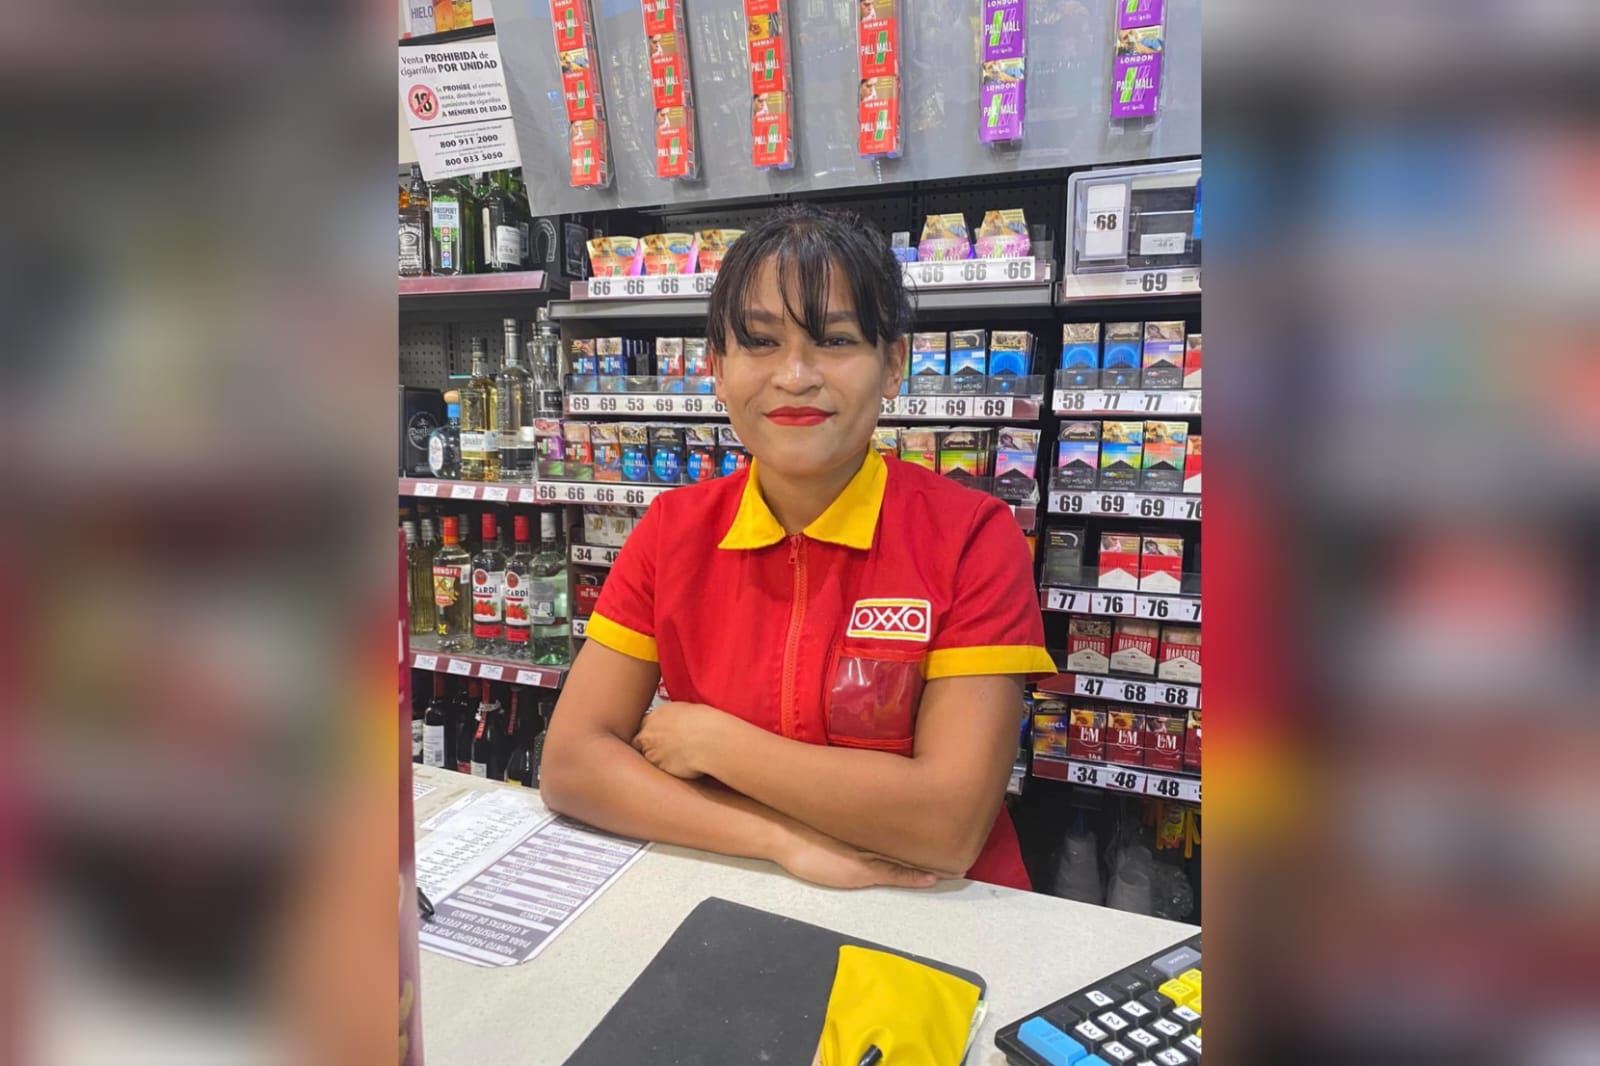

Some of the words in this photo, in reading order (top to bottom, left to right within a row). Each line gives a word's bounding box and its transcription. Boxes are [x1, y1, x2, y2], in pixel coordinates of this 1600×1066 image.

[411, 4, 434, 19] HIELO
[985, 22, 1001, 36] PALL
[1002, 21, 1021, 33] MALL
[861, 45, 875, 56] PALL
[876, 42, 893, 53] MALL
[401, 56, 424, 65] Venta
[424, 51, 478, 63] PROHIBIDA
[479, 51, 489, 59] de
[1120, 54, 1154, 63] LONDON
[400, 66, 437, 77] cigarrillos
[438, 63, 458, 73] POR
[460, 60, 498, 71] UNIDAD
[985, 82, 1017, 92] LONDON
[1116, 79, 1133, 91] PALL
[1134, 77, 1154, 89] MALL
[448, 108, 478, 117] MENORES
[479, 106, 488, 114] DE
[489, 104, 507, 112] EDAD
[983, 105, 999, 117] PALL
[1000, 102, 1018, 115] MALL
[861, 122, 875, 132] PALL
[876, 120, 892, 130] MALL
[440, 140, 457, 148] 800
[458, 137, 474, 146] 911
[477, 134, 499, 144] 2000
[445, 157, 462, 167] 800
[463, 155, 480, 164] 033
[482, 151, 503, 161] 5050
[474, 585, 497, 594] CARDÍ
[506, 588, 529, 597] CARDÍ
[854, 605, 925, 633] OXXO
[1073, 639, 1105, 655] MARLBORO
[1119, 639, 1152, 656] MARLBORO
[1166, 647, 1200, 664] MARLBORO
[431, 914, 462, 928] EFECTIV
[450, 909, 478, 921] BANCO
[476, 916, 489, 925] DE
[435, 927, 454, 937] POR
[460, 922, 474, 931] EN
[486, 920, 521, 933] CUENTAS
[484, 941, 517, 955] MONTO
[508, 936, 532, 948] PARA
